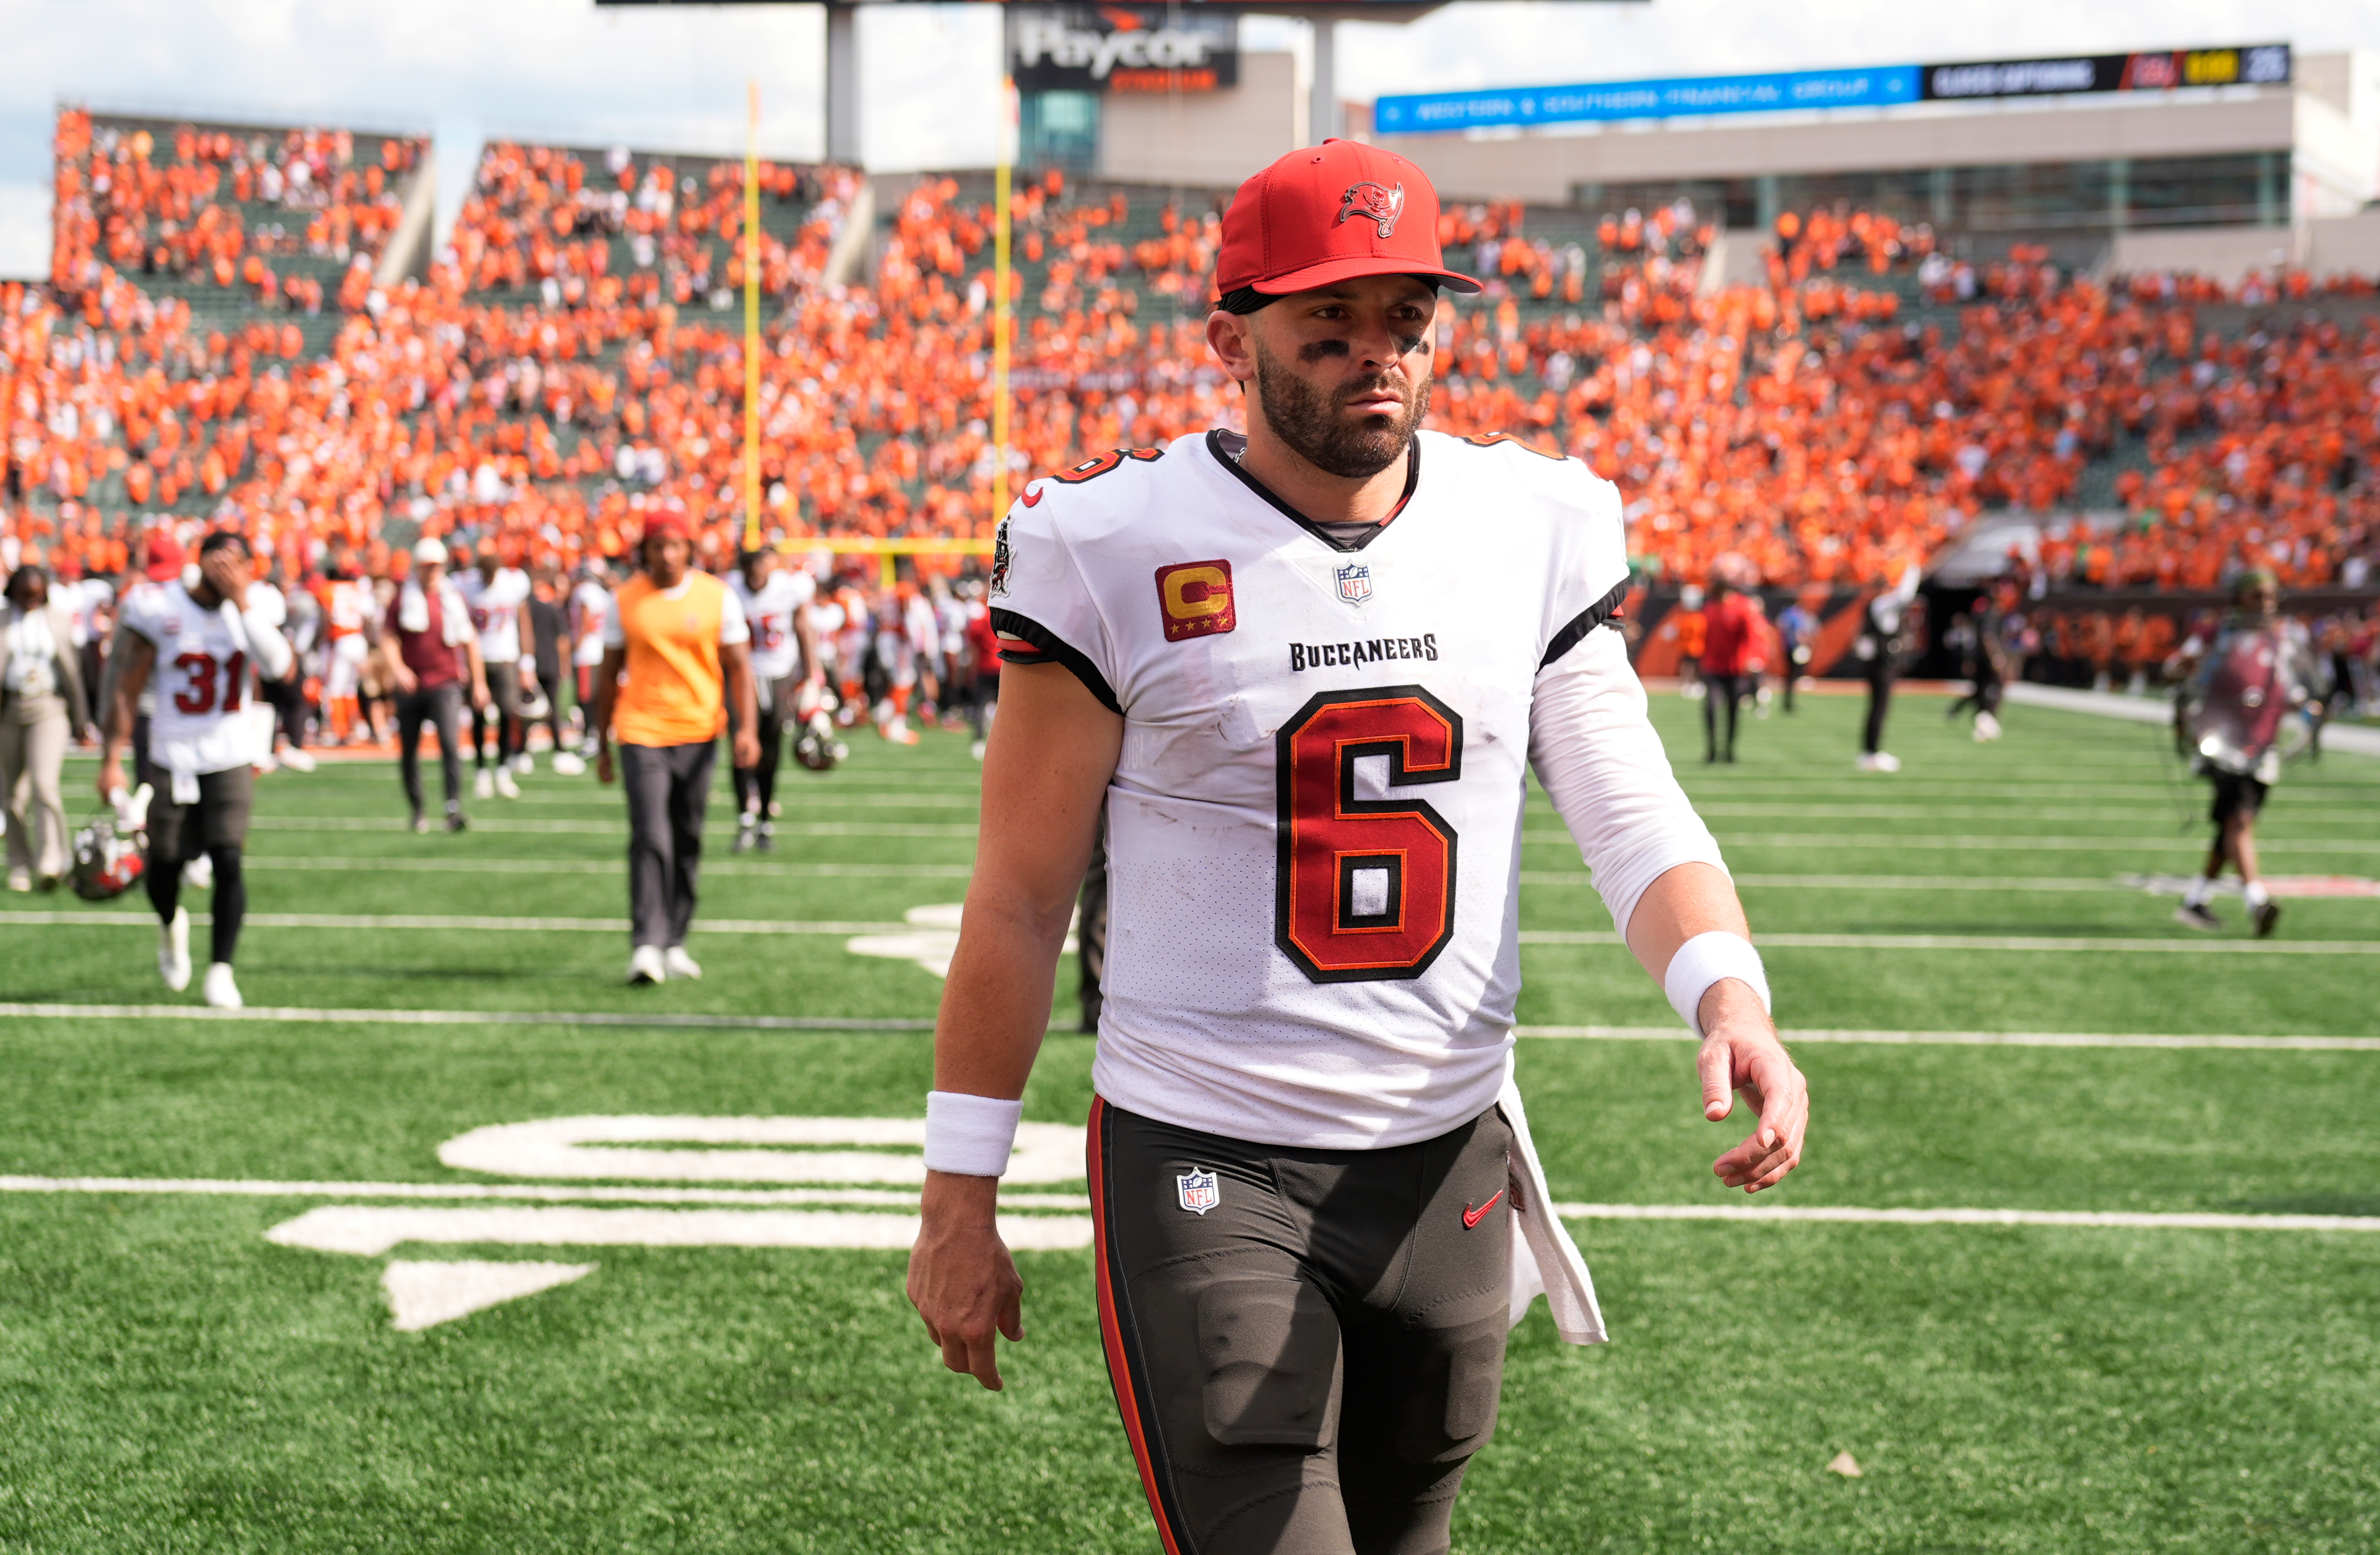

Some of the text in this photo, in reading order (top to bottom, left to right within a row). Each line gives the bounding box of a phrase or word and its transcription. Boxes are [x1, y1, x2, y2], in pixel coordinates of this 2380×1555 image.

[1021, 16, 1214, 80] Paycor
[1164, 566, 1228, 620] C
[1342, 579, 1369, 597] NFL
[1288, 633, 1438, 672] BUCCANEERS
[174, 652, 246, 714] 31
[1275, 683, 1463, 984] 6
[1186, 1189, 1212, 1206] NFL
